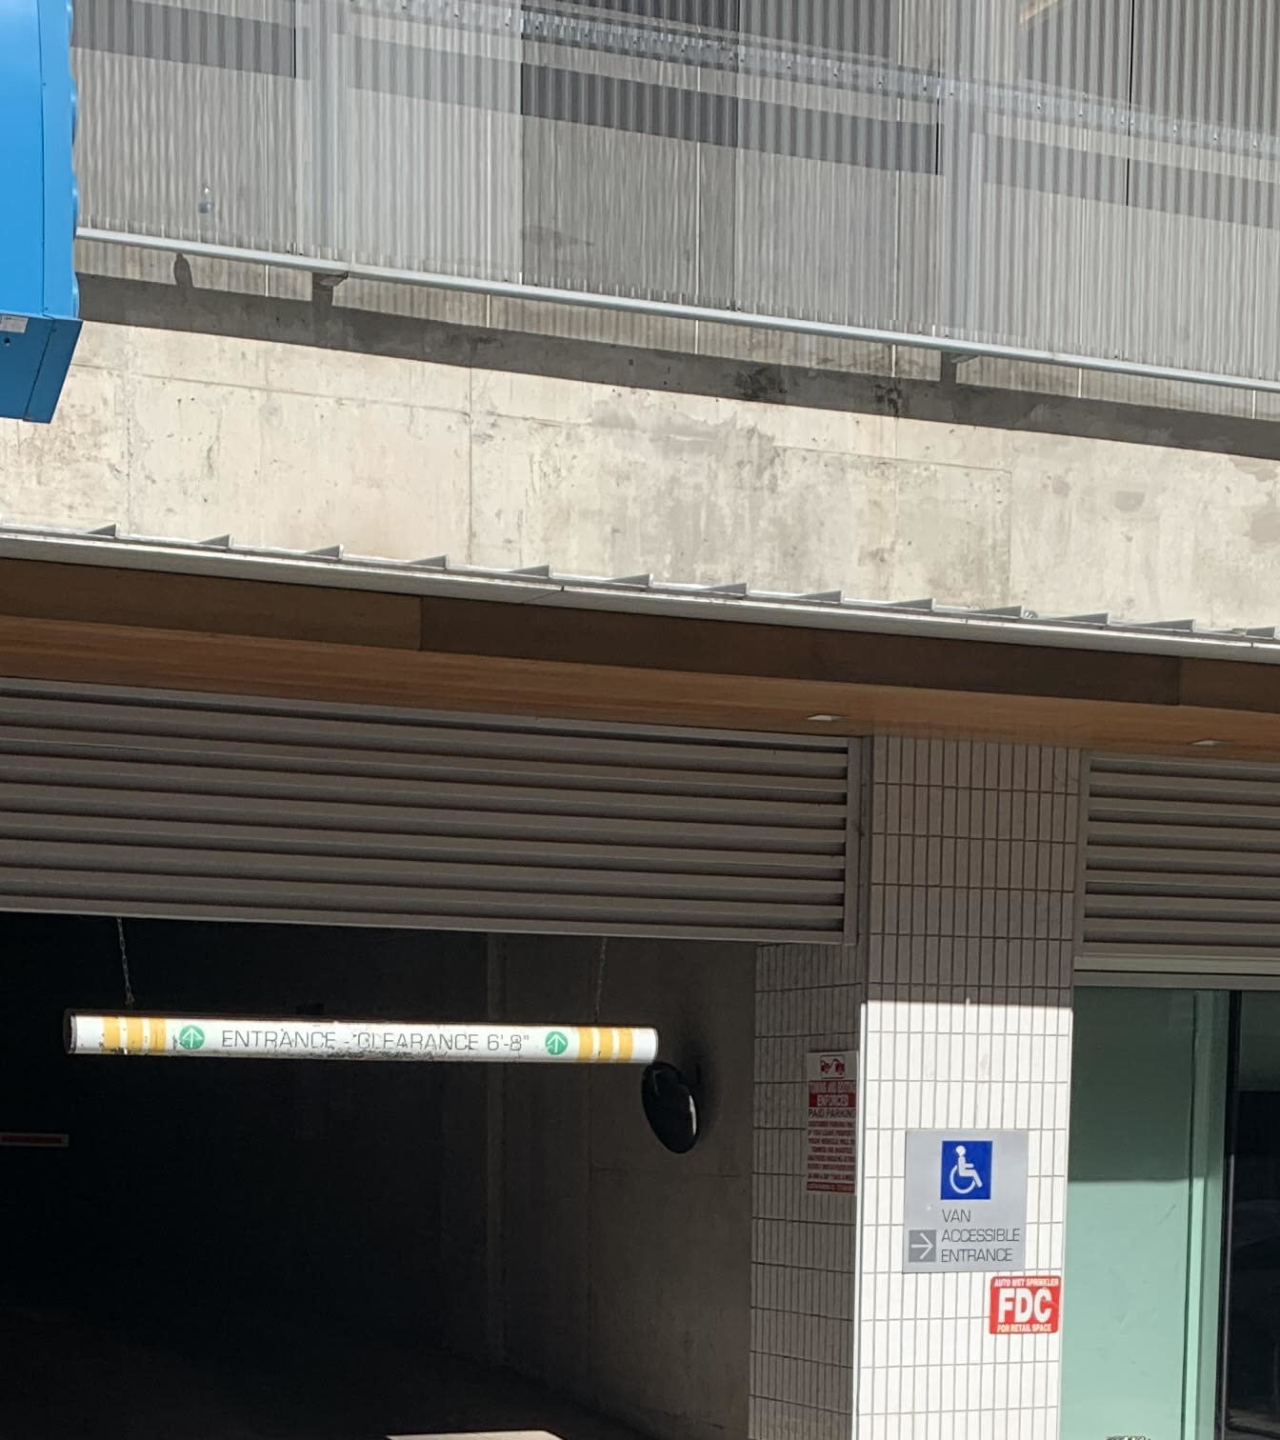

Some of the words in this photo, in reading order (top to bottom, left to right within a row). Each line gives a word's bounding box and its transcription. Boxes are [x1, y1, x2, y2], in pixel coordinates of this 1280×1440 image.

[222, 1029, 336, 1049] ENTRANCE
[357, 1032, 480, 1051] CLEARANCE
[941, 1208, 971, 1223] VAN
[941, 1227, 1020, 1243] ACCESSIBLE
[941, 1247, 1013, 1263] ENTRANCE
[998, 1287, 1053, 1323] FDC
